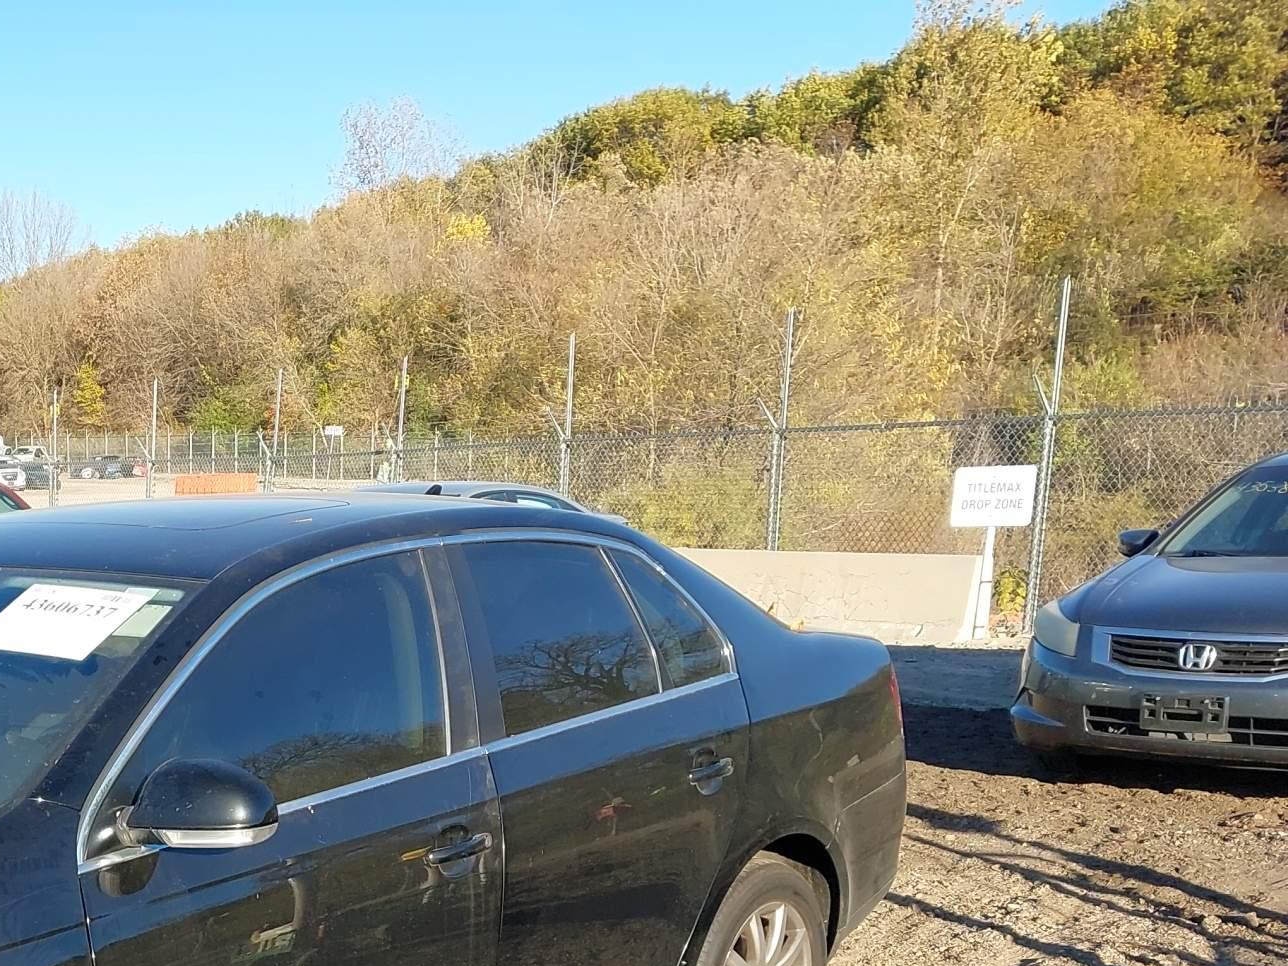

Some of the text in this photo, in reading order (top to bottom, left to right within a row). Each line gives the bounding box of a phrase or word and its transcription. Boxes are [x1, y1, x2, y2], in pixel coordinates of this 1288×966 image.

[967, 482, 1022, 494] TITLEMAX
[961, 498, 1025, 510] DROP ZONE
[23, 598, 118, 618] 43606737
